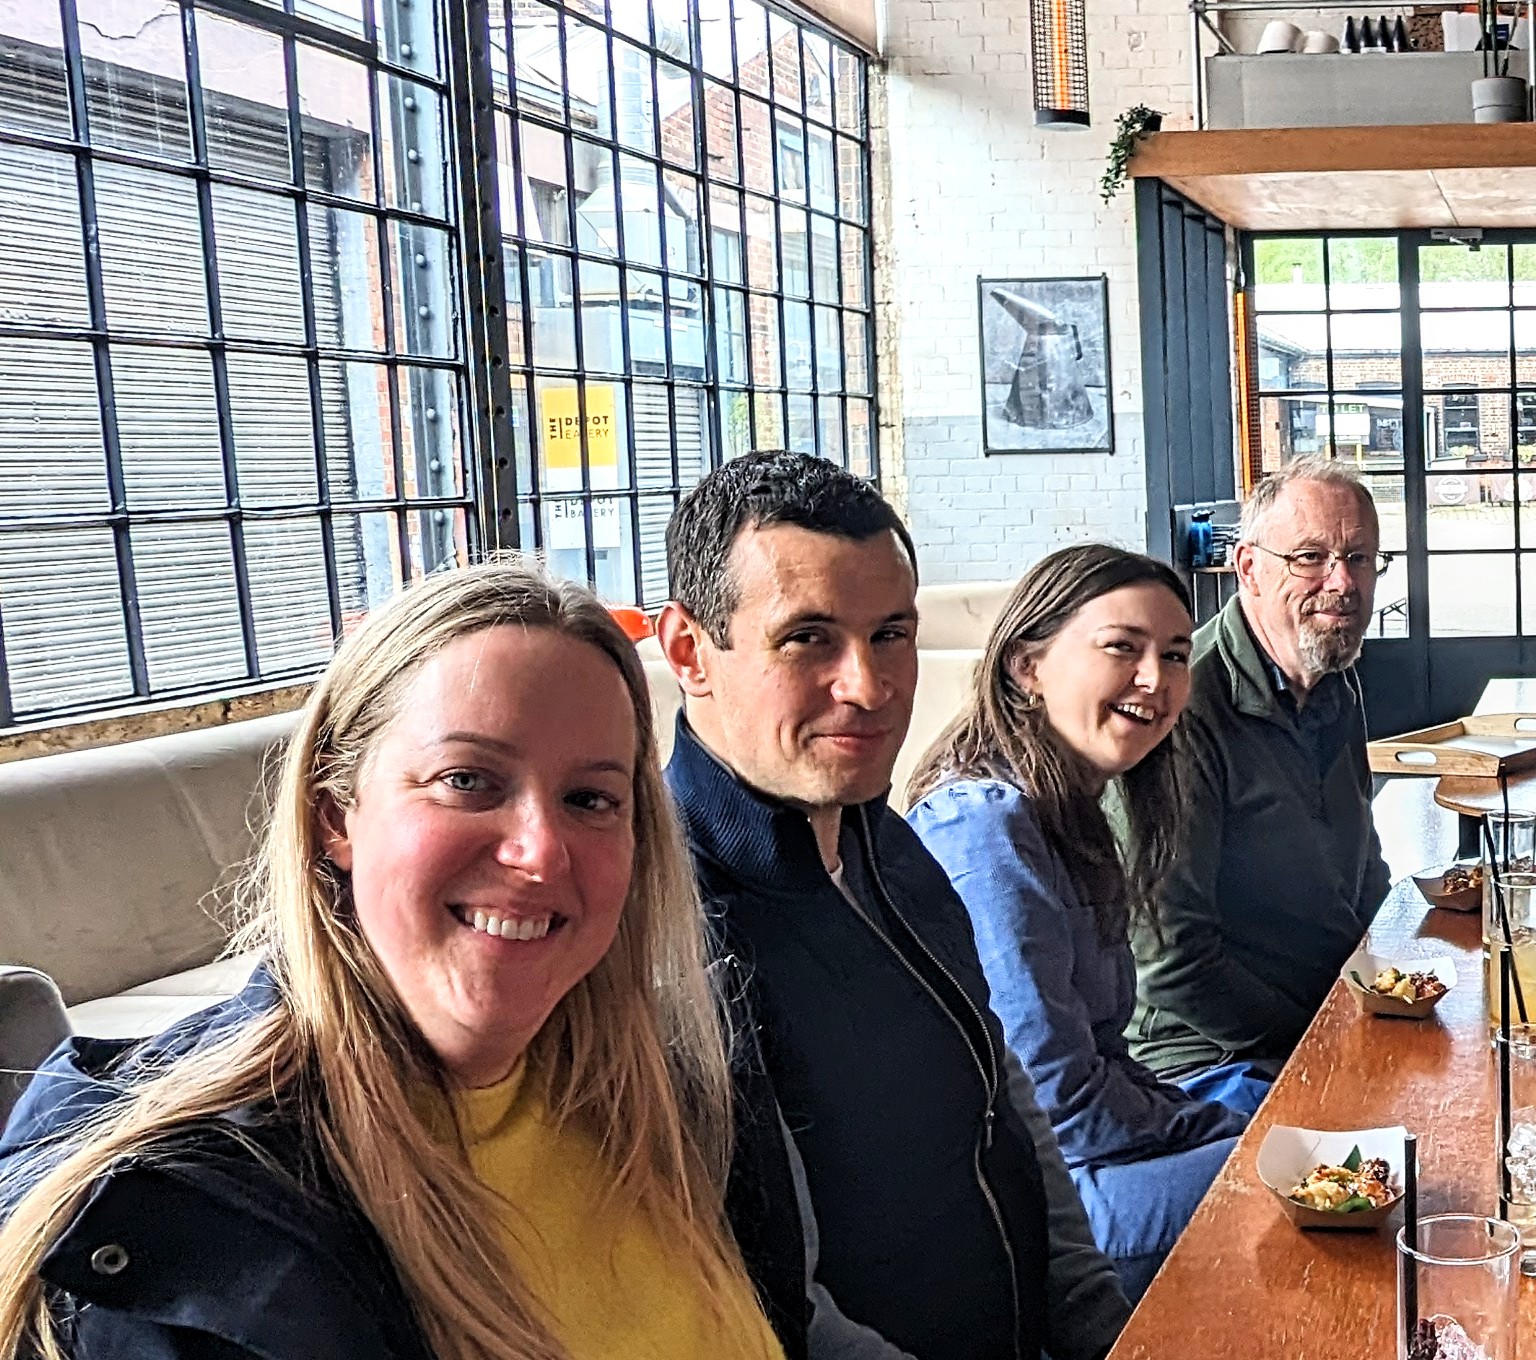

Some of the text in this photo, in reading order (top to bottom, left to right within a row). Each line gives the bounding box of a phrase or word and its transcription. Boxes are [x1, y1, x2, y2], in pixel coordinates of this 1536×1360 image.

[1341, 404, 1366, 414] LET
[549, 418, 557, 440] THE
[565, 428, 609, 440] EAERY
[571, 508, 614, 519] BAERY
